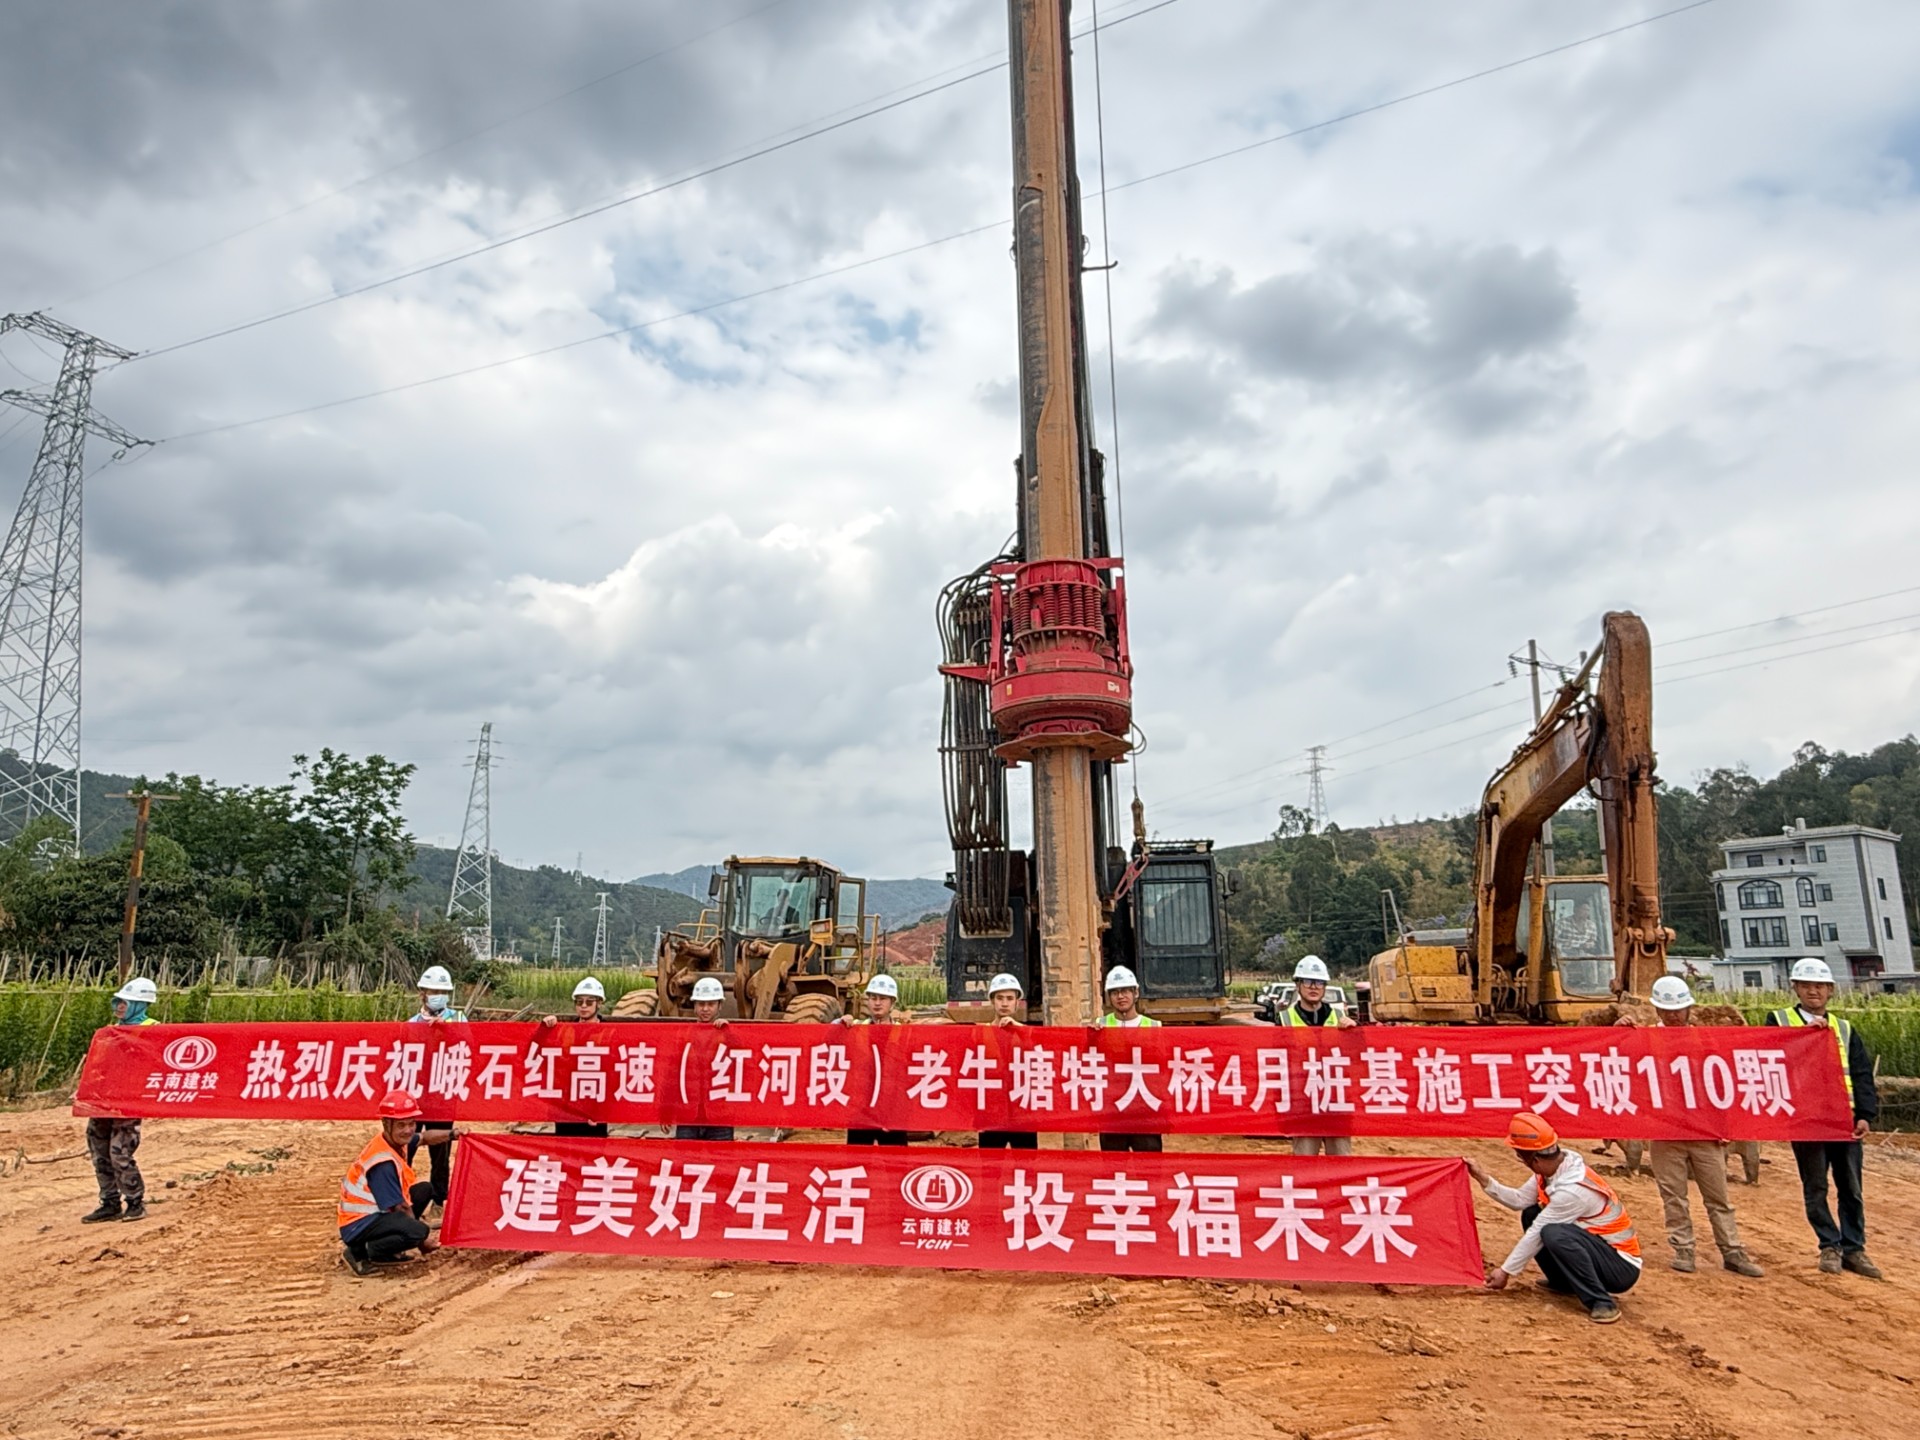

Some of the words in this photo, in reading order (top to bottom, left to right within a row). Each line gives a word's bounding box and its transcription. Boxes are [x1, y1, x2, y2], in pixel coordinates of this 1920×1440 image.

[145, 1071, 219, 1090] 云南建投
[156, 1091, 199, 1103] YCIH
[494, 1154, 870, 1246] 建美好生活
[1002, 1168, 1418, 1264] 投幸福未来
[902, 1217, 970, 1236] 云南建投
[916, 1238, 953, 1250] YCIH
